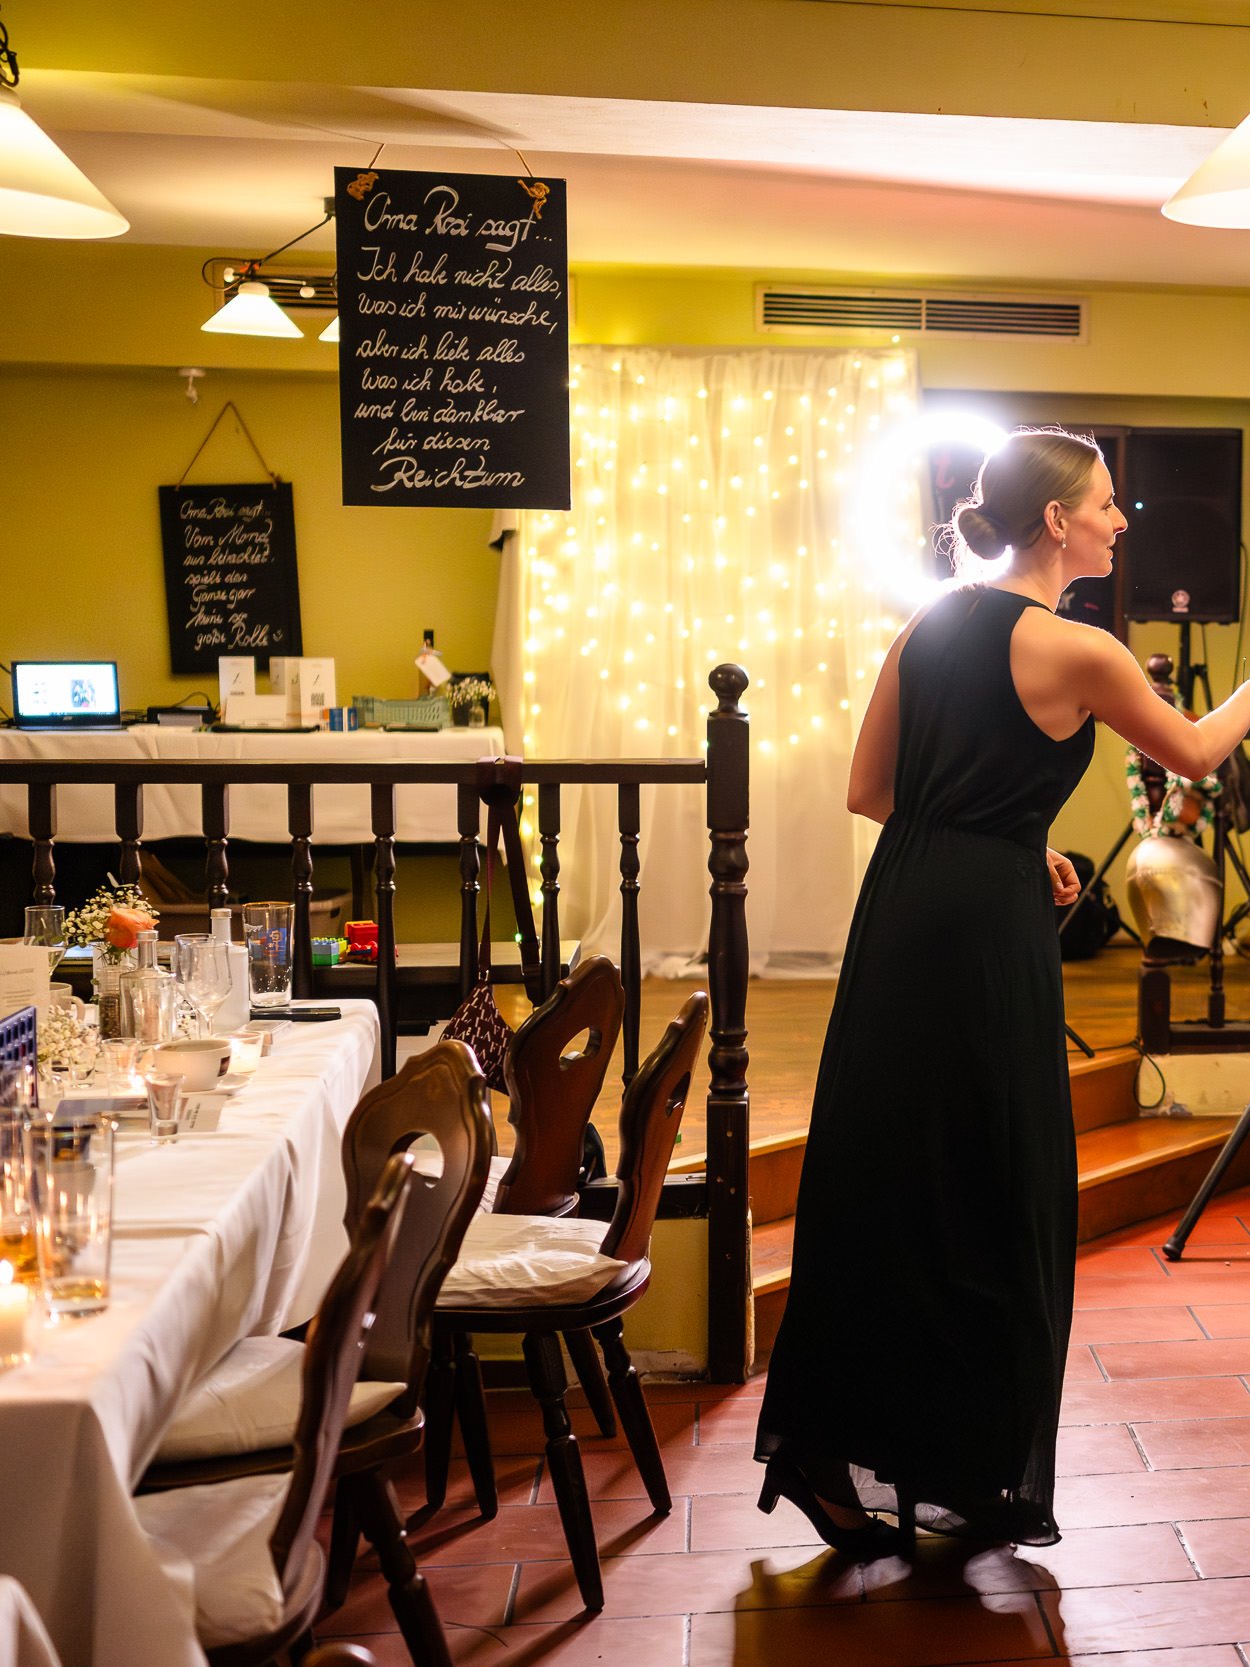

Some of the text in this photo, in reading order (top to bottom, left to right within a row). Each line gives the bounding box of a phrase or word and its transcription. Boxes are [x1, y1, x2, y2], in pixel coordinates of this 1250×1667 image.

[357, 246, 562, 300] Ich habe nicht alles,
[399, 291, 427, 318] ich
[433, 301, 467, 320] mir
[468, 297, 558, 335] wünsche,
[356, 328, 526, 363] aber ich liebe alles
[402, 367, 434, 391] ich
[353, 397, 526, 424] und bin dankbar
[372, 426, 491, 455] für diesen
[370, 455, 526, 492] Reichtum
